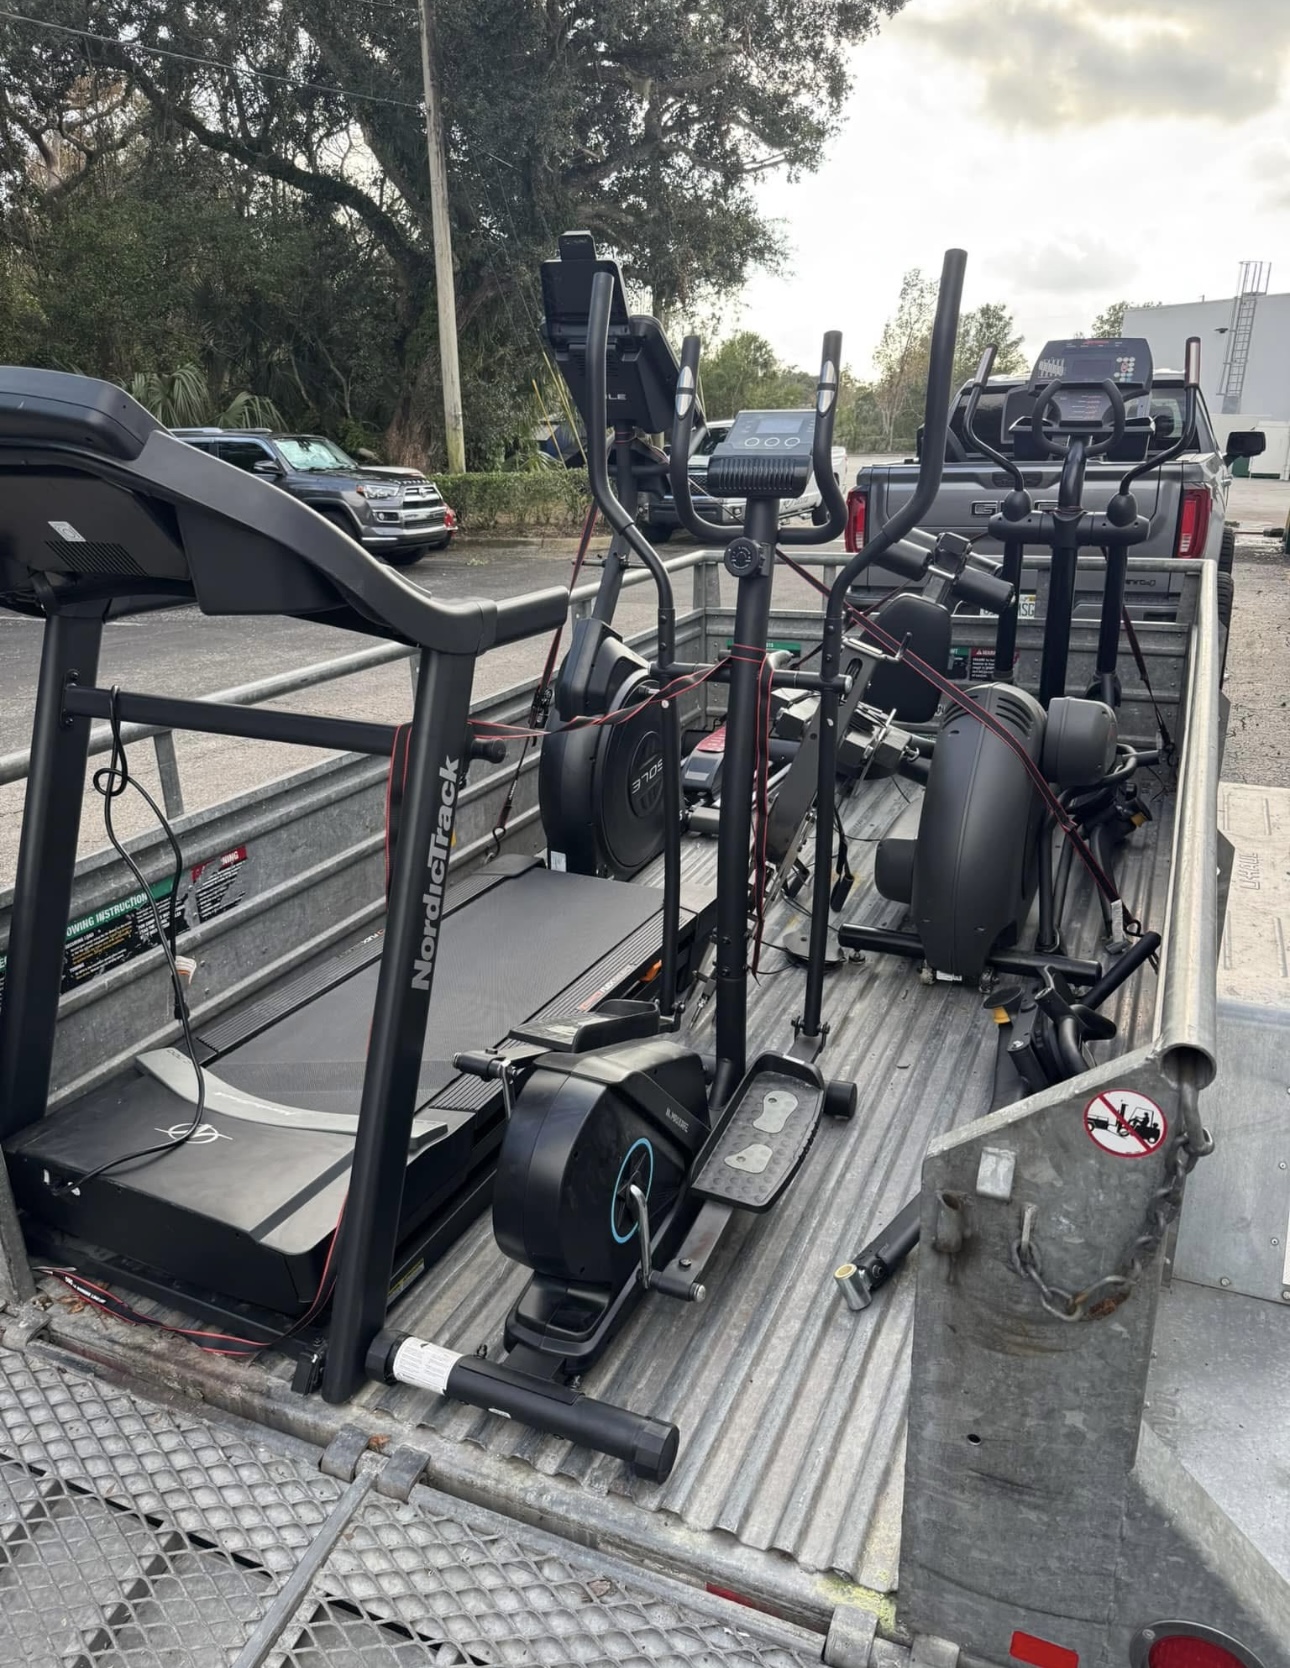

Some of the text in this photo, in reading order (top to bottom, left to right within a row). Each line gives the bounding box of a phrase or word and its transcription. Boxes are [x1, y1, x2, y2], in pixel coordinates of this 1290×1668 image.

[66, 916, 95, 937] OWING
[95, 892, 148, 923] INSTRUCTION
[411, 755, 460, 991] NordicTrack
